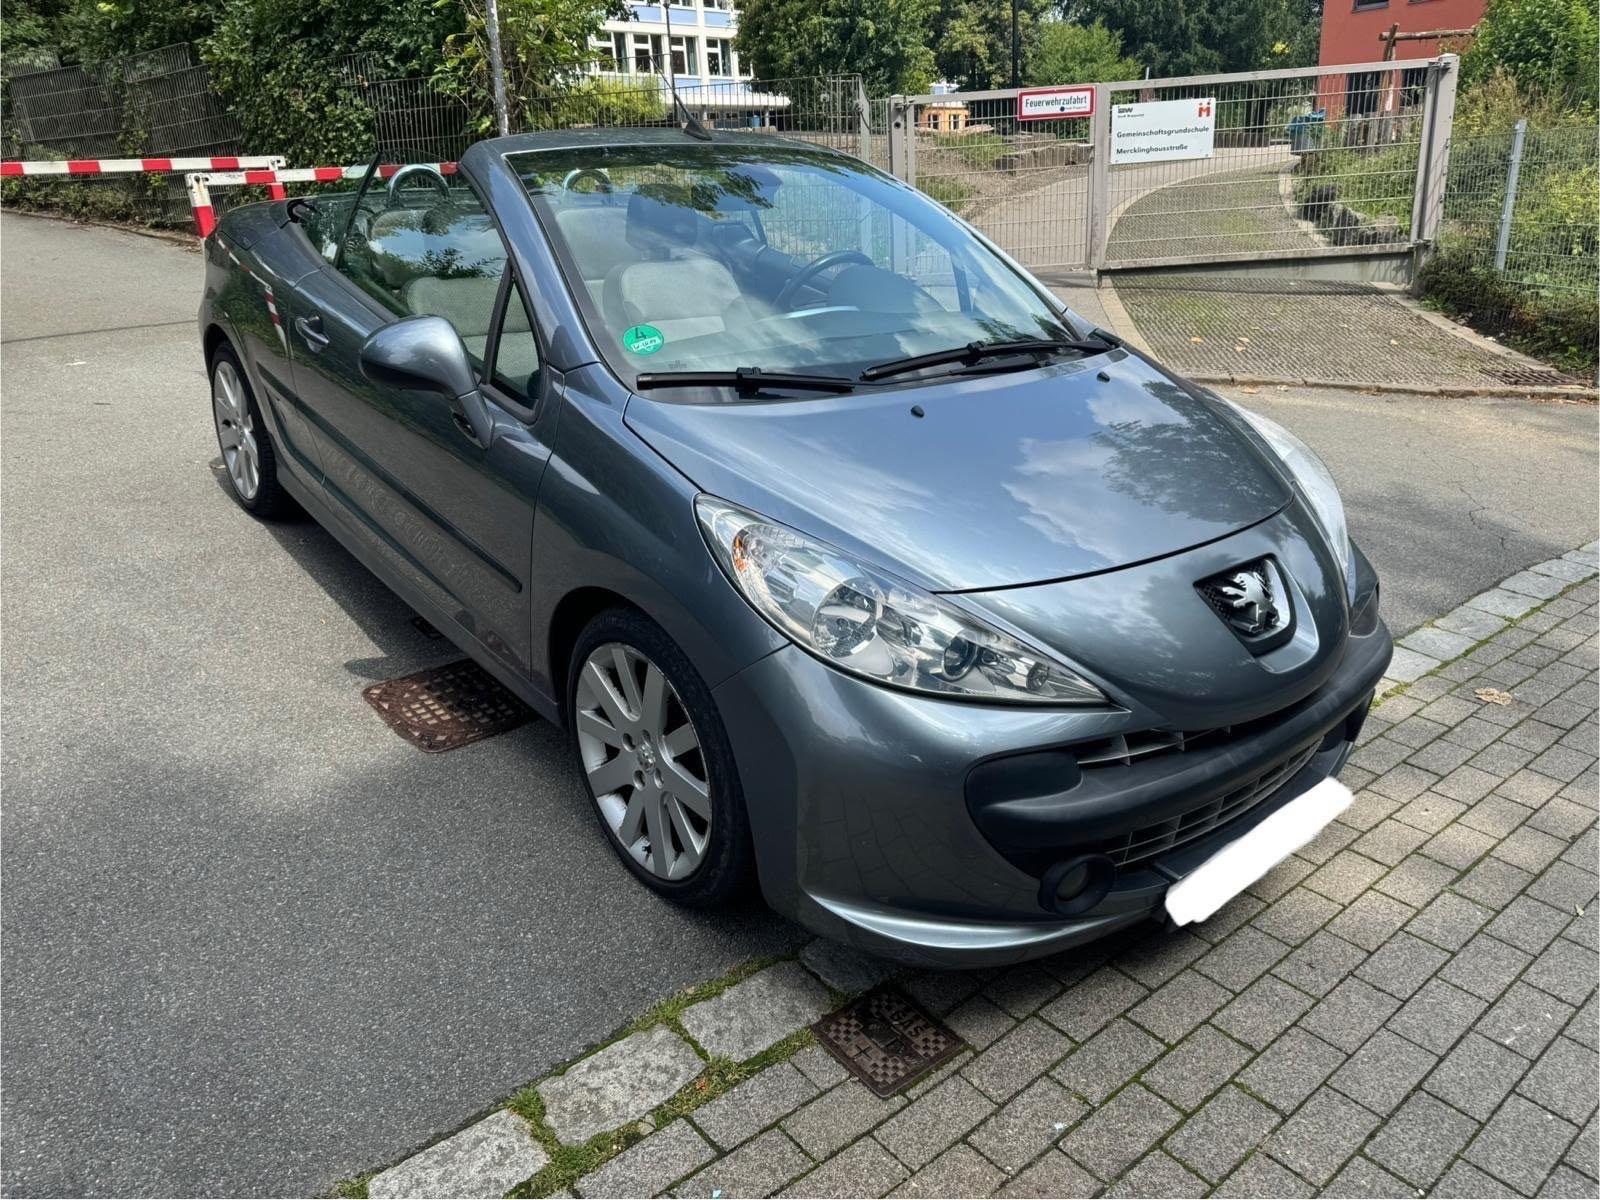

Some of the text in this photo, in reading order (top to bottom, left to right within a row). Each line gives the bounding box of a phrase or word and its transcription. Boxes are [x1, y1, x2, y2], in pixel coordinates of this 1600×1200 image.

[1025, 96, 1087, 108] Feuerwehrzufahrt
[1116, 125, 1210, 139] Gemeinschaftsgrundschule
[1116, 144, 1188, 155] Mercklinghausstraße
[634, 327, 647, 339] 4
